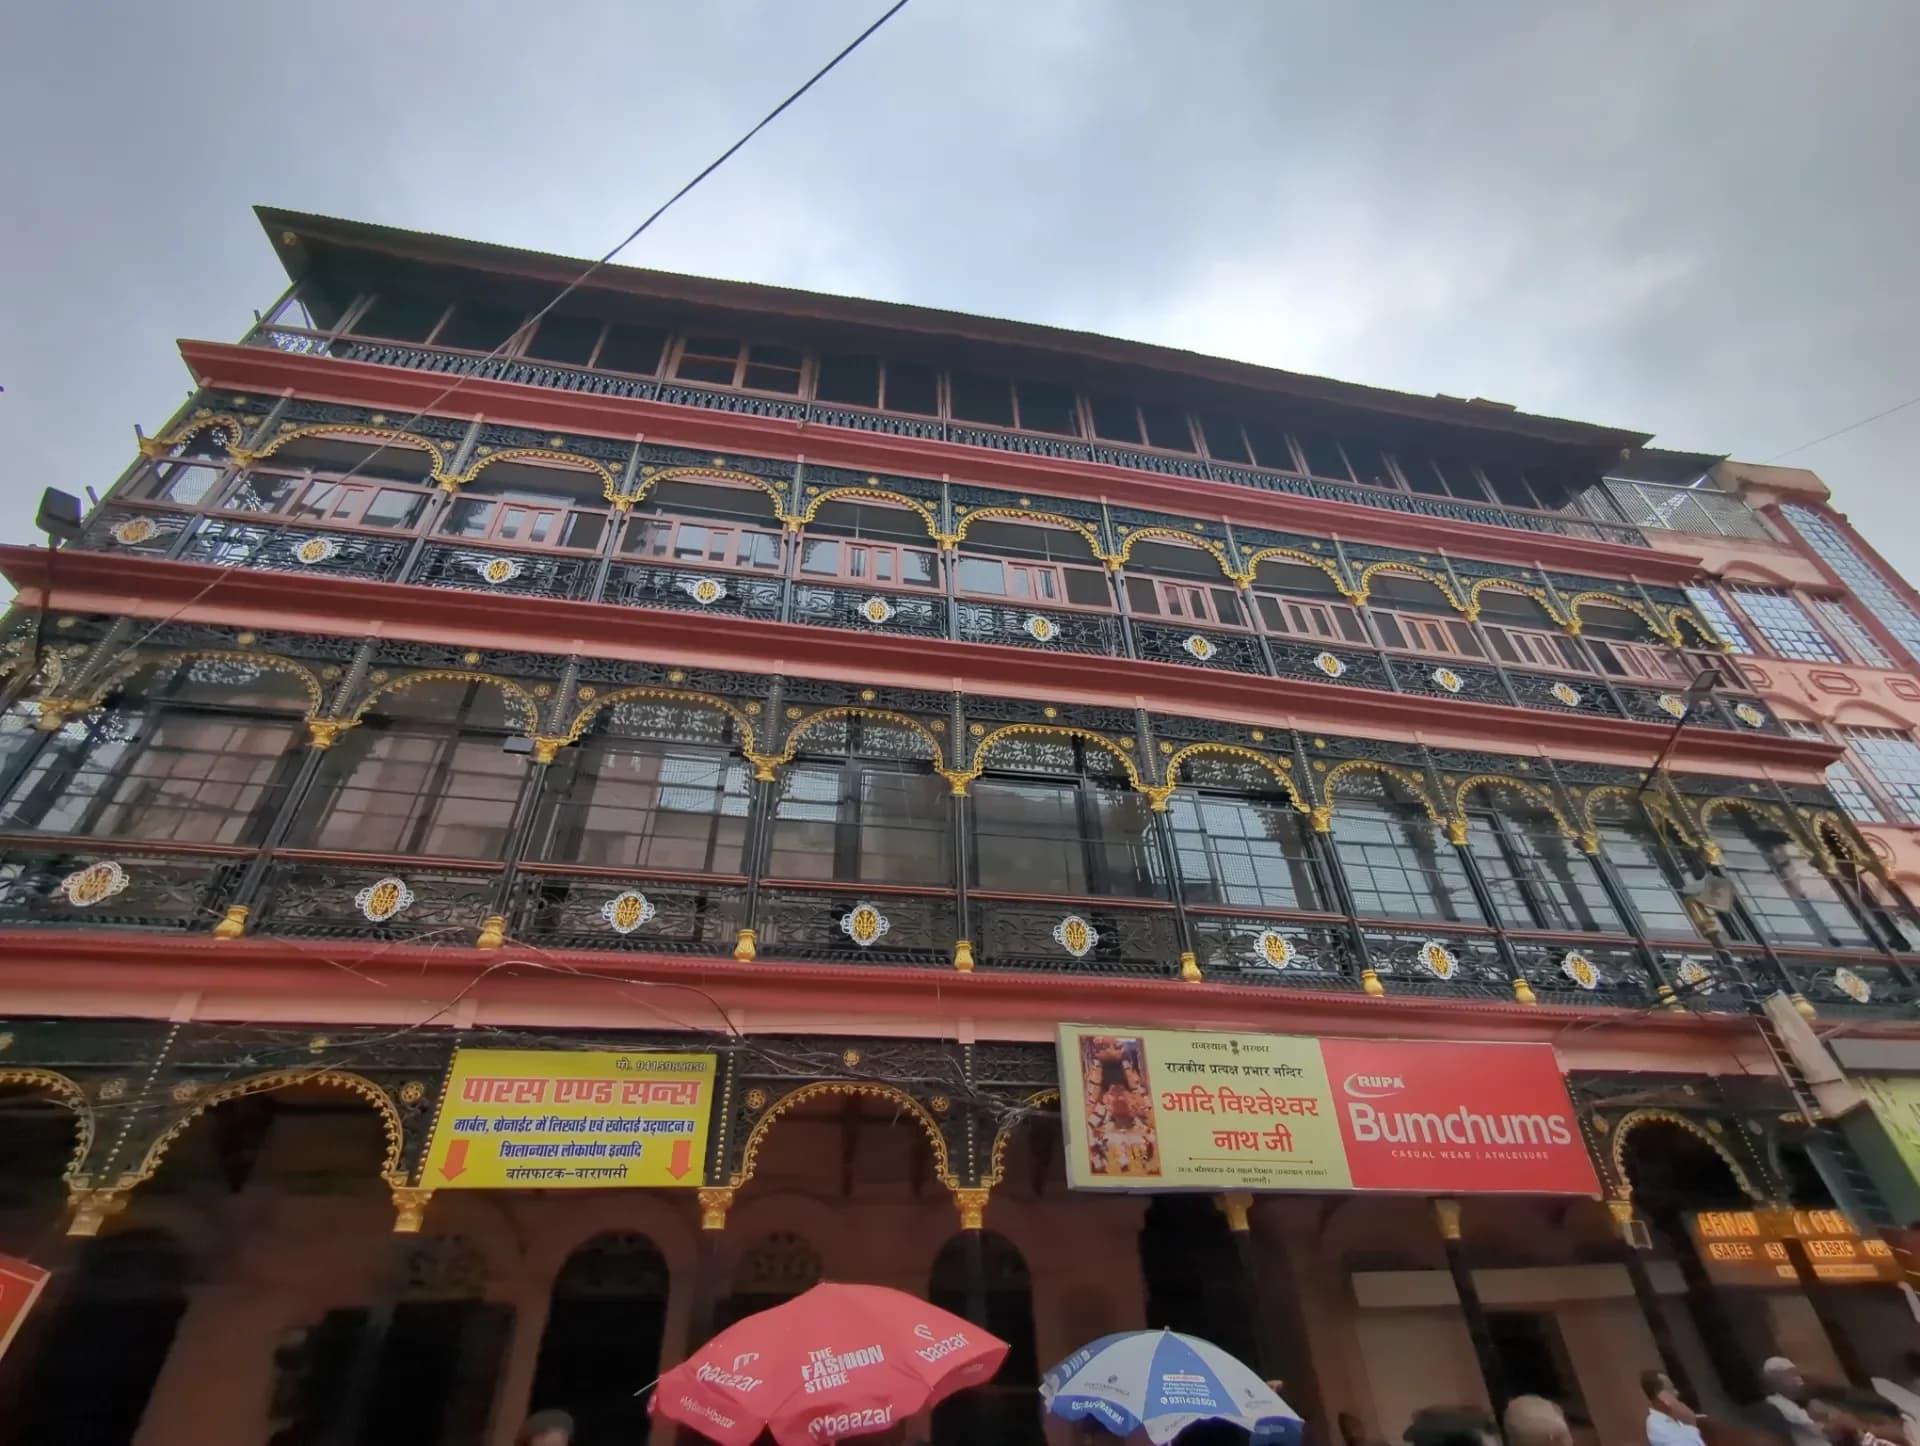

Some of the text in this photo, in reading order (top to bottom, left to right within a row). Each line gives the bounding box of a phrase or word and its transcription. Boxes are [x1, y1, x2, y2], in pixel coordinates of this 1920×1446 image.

[1164, 1059, 1207, 1073] राजकीय
[1273, 1063, 1304, 1079] मन्दिर
[463, 1077, 701, 1105] पारस एण्ड सन्स
[1357, 1075, 1405, 1089] RUPA
[1161, 1085, 1319, 1117] आदि विश्वेश्वर
[535, 1115, 549, 1132] में
[549, 1115, 588, 1133] लिखाई
[589, 1116, 605, 1133] एवं
[1347, 1102, 1572, 1145] Bumchums
[1212, 1122, 1293, 1153] नाथ जी
[499, 1140, 560, 1158] शिलान्यास
[608, 1140, 642, 1158] इत्यादि
[1391, 1149, 1436, 1159] CASUAL
[1440, 1150, 1471, 1160] WEAR
[1811, 1241, 1855, 1256] FABRIC
[808, 1346, 833, 1363] THE
[915, 1332, 969, 1363] baazar
[801, 1343, 885, 1381] FASHION
[804, 1371, 850, 1394] STORE
